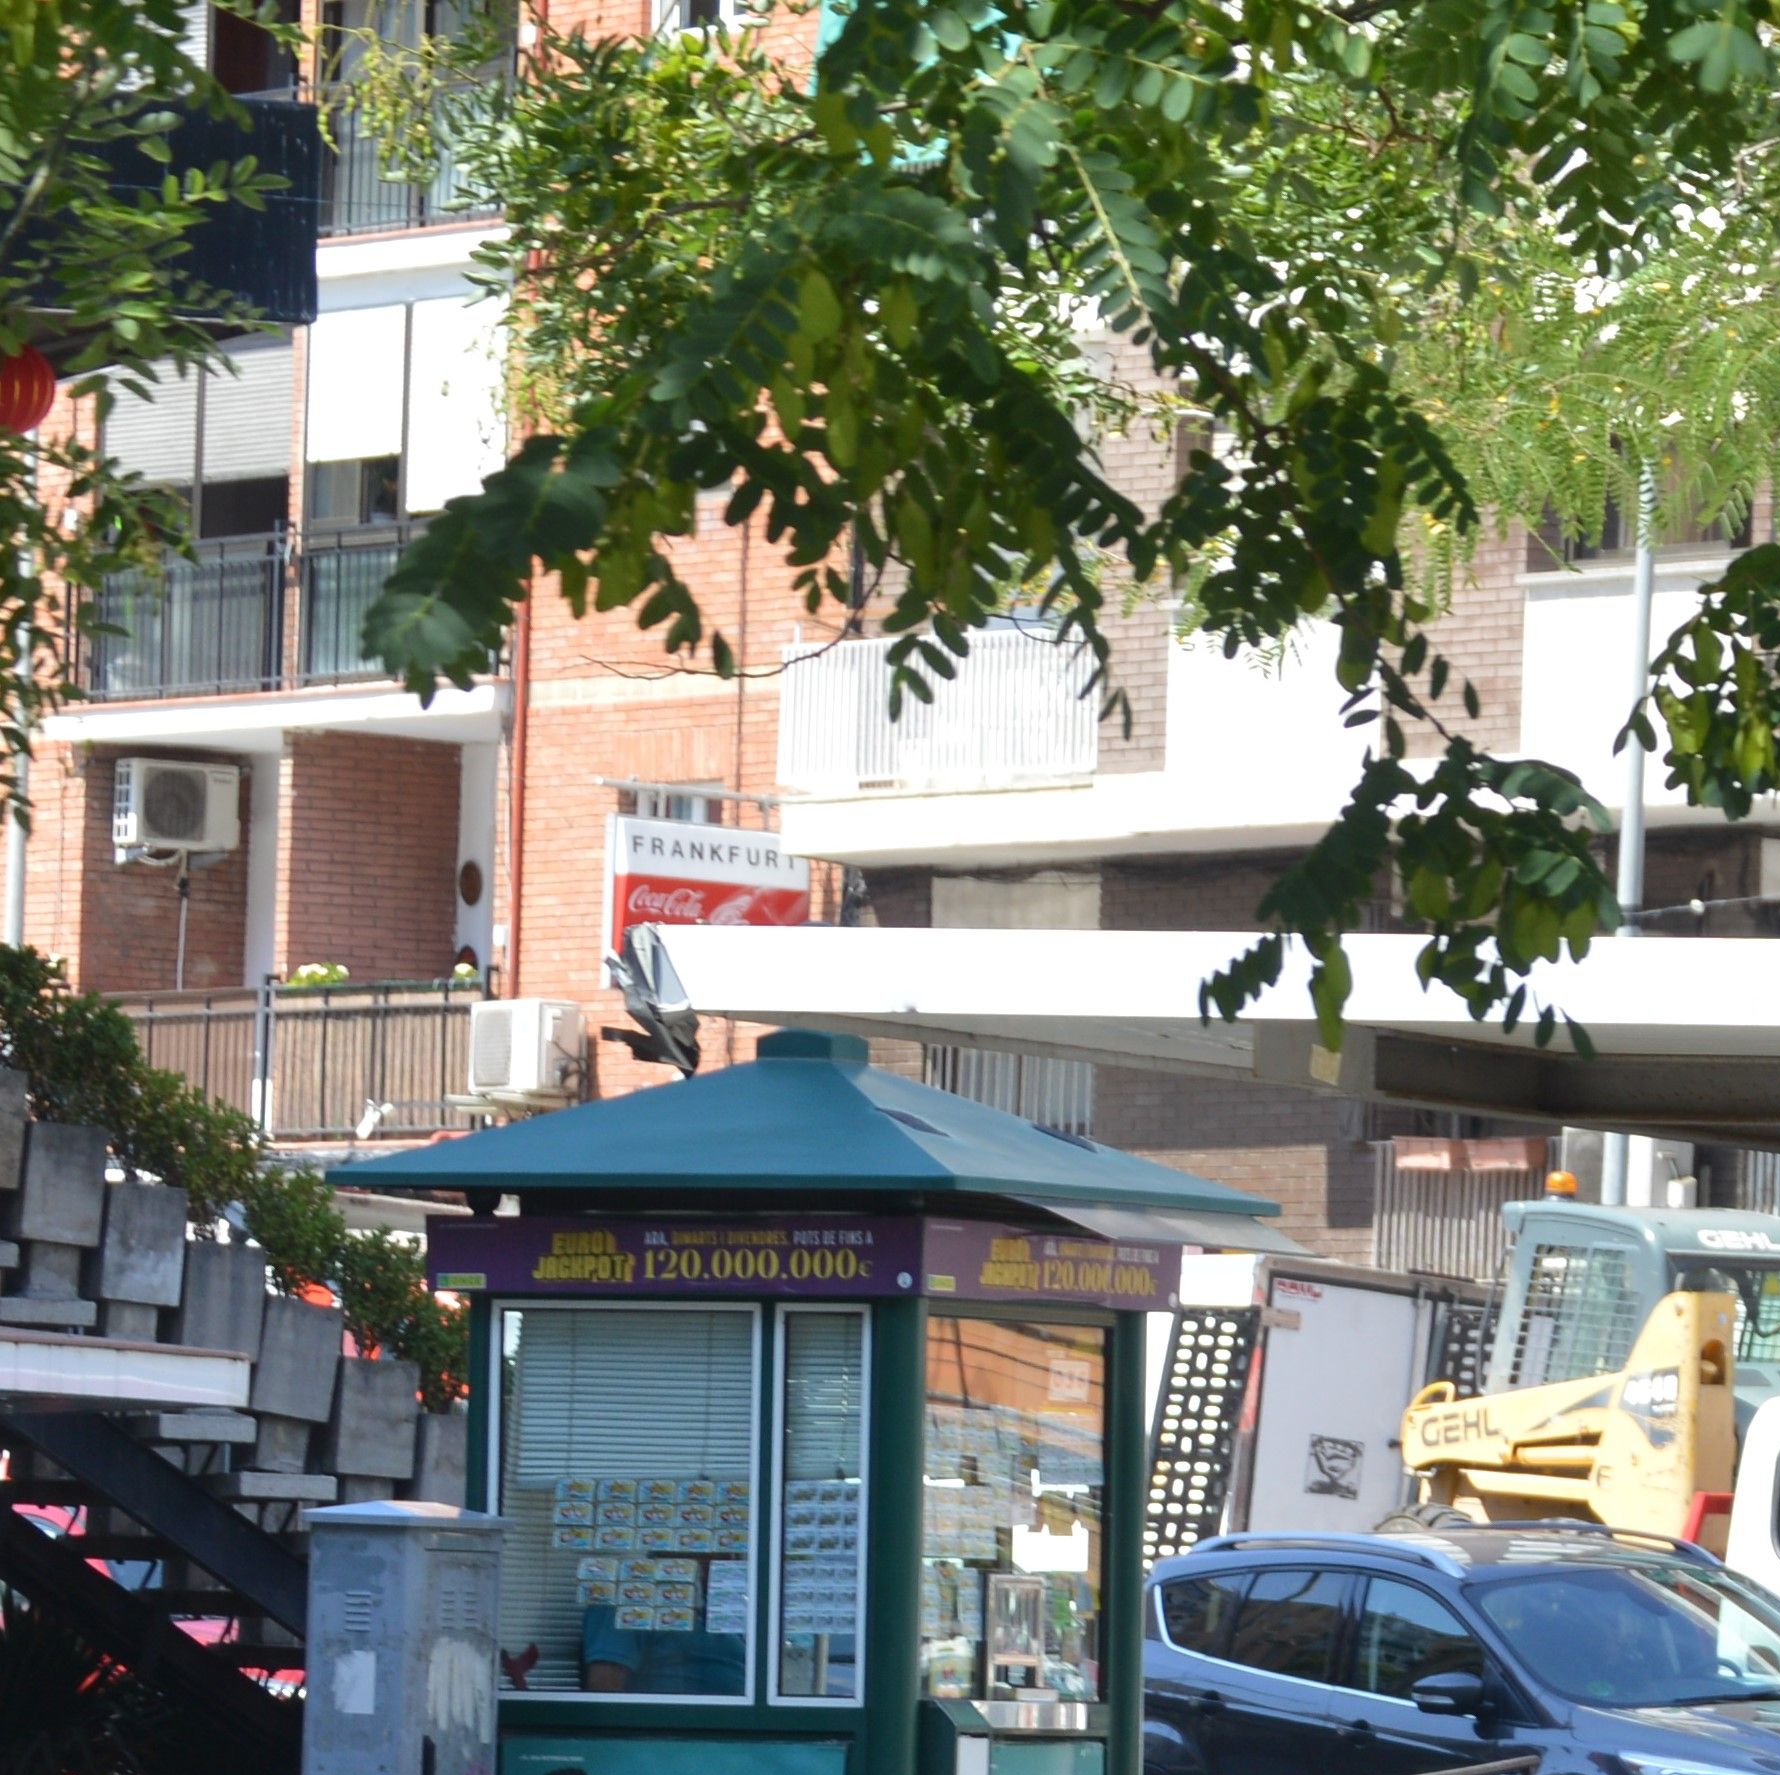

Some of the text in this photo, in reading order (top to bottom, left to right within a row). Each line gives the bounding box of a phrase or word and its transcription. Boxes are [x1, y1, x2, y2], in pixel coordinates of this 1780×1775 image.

[632, 835, 797, 870] FRANKFURT
[628, 884, 705, 918] Coca-Cola
[644, 1248, 874, 1281] 120.000.000€
[1421, 1407, 1502, 1448] GEHL
